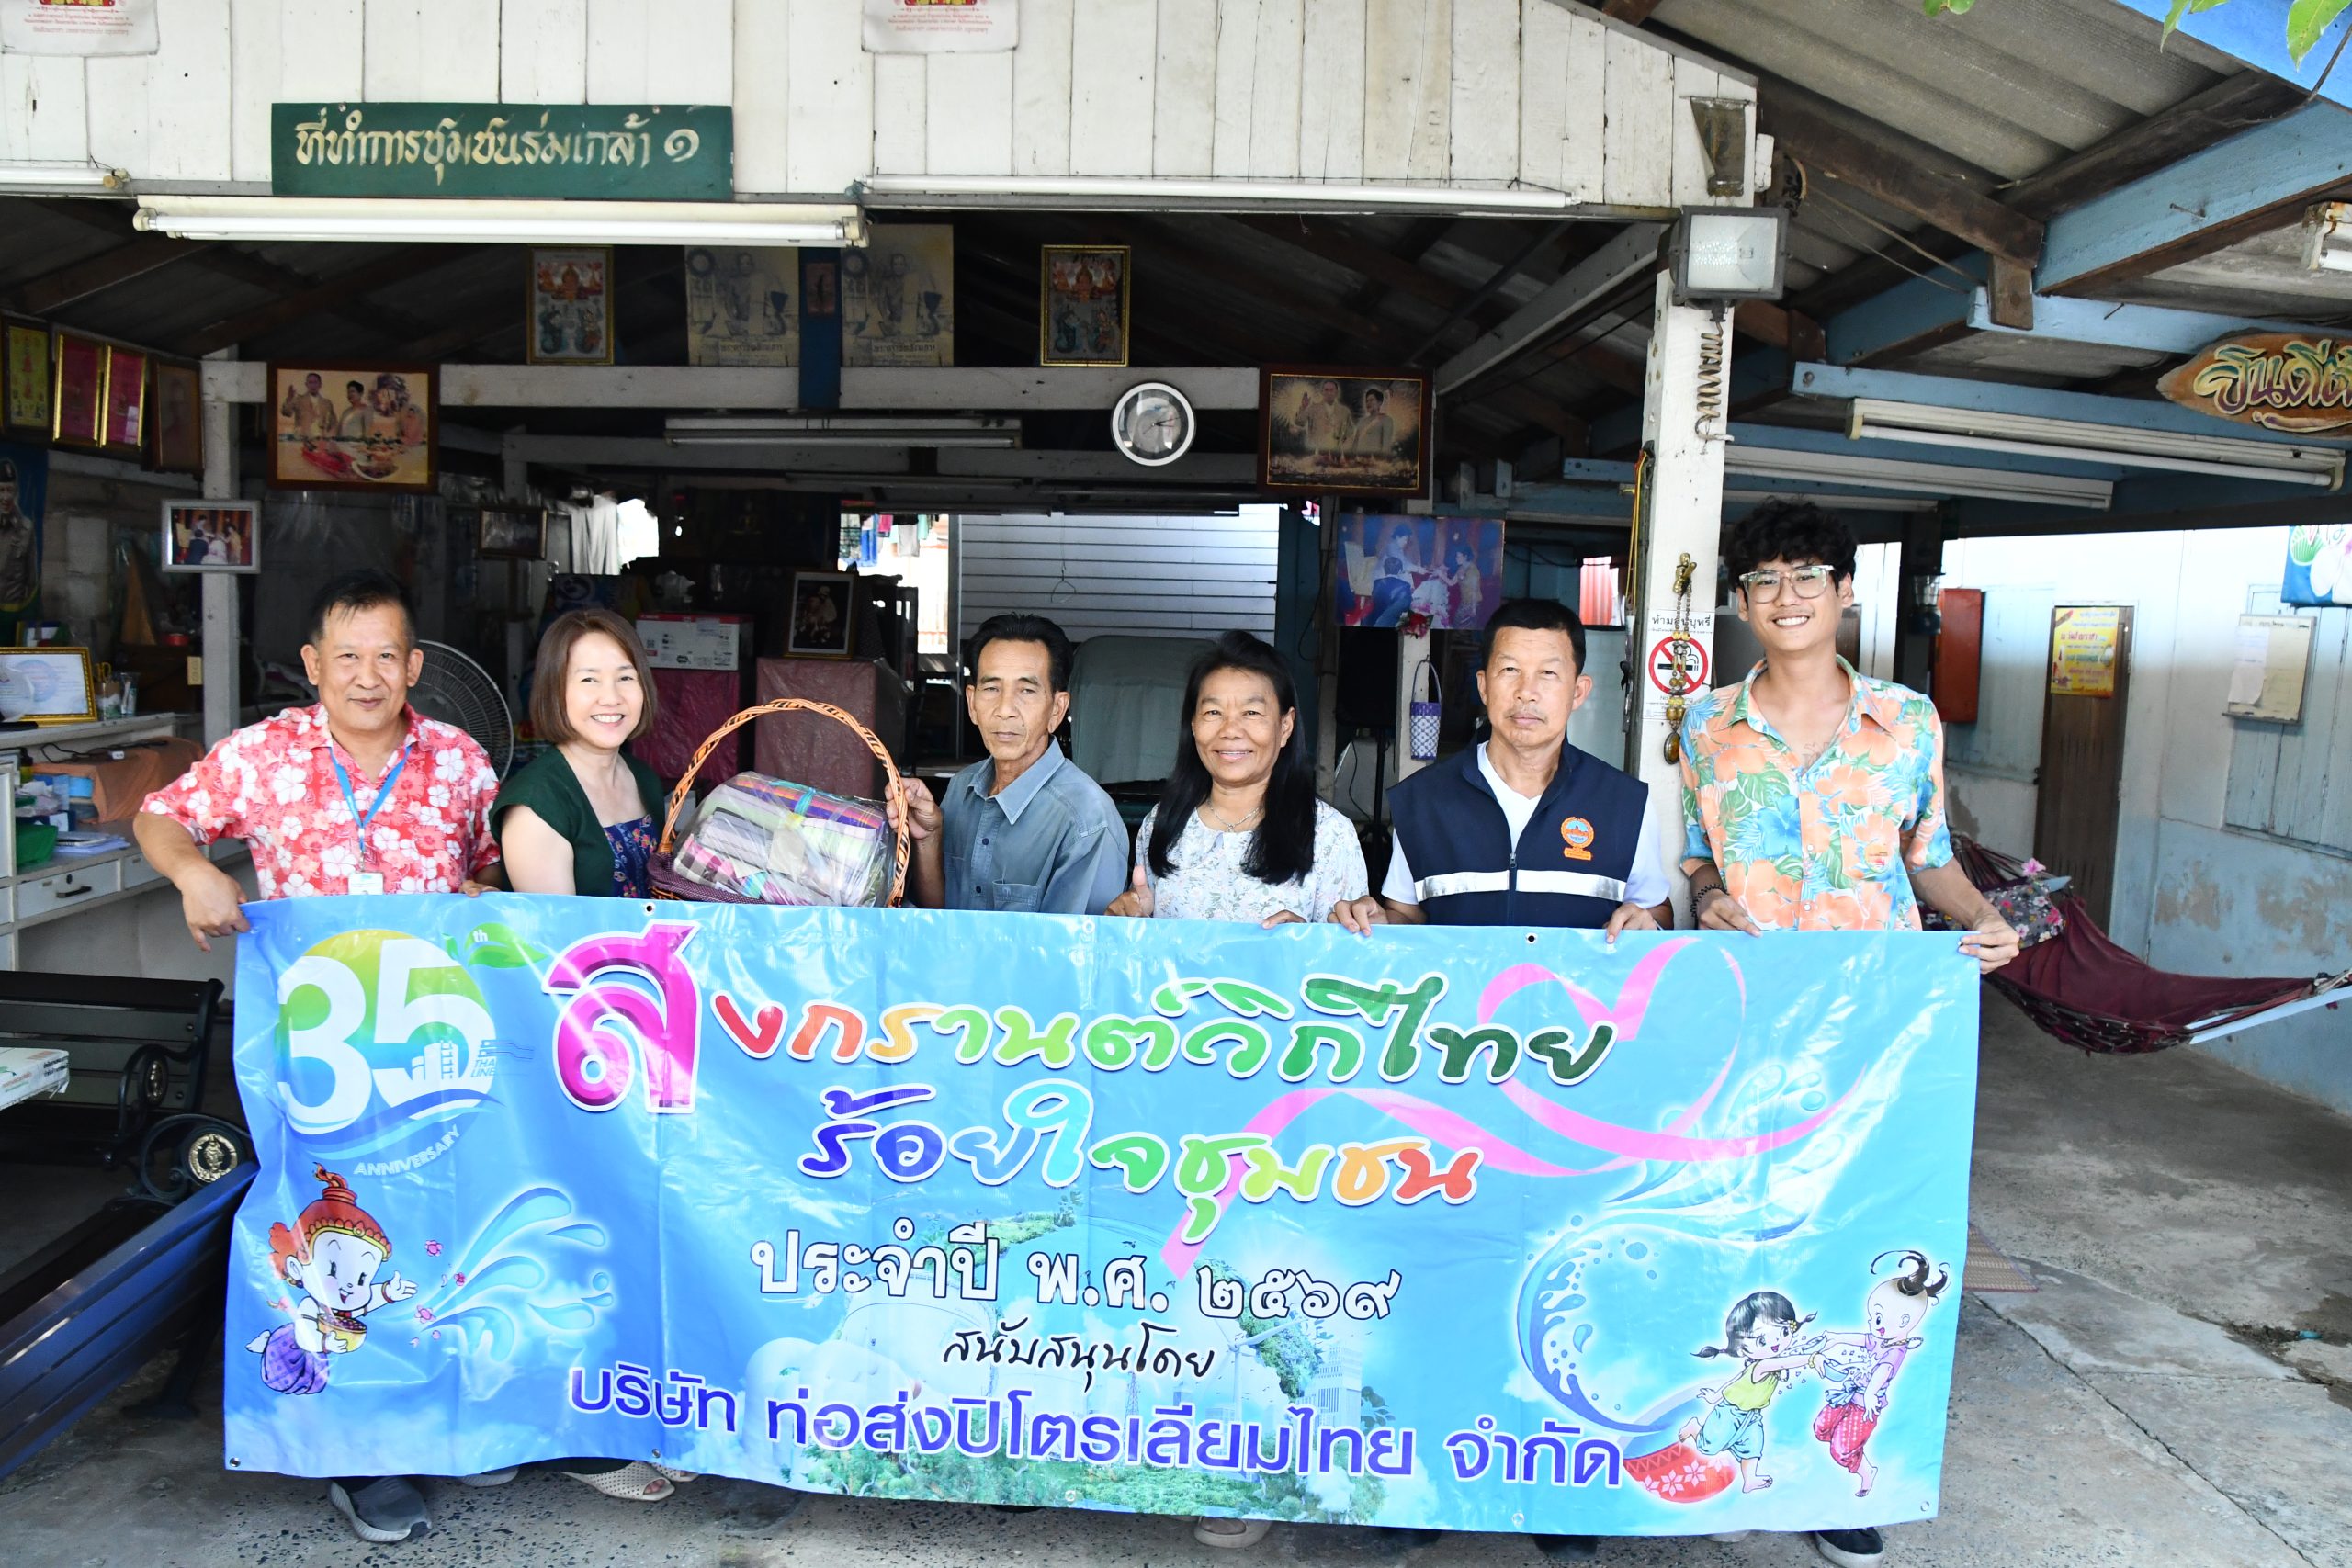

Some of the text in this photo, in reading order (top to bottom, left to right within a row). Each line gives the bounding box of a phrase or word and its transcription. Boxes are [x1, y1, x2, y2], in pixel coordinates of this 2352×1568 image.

[663, 128, 700, 163] ๑
[277, 929, 497, 1135] 35 th
[353, 1123, 460, 1176] ANNIVERSARY
[797, 1078, 1484, 1245] ร้อยใจชุมชน
[750, 1220, 1404, 1321] ประจำปี พ.ศ. ๒๕๖๙
[942, 1318, 1216, 1393] สนับสนุนโดย
[570, 1362, 1624, 1489] บริษัท ท่อส่งปิโตรเลียมไทย จำกัด
